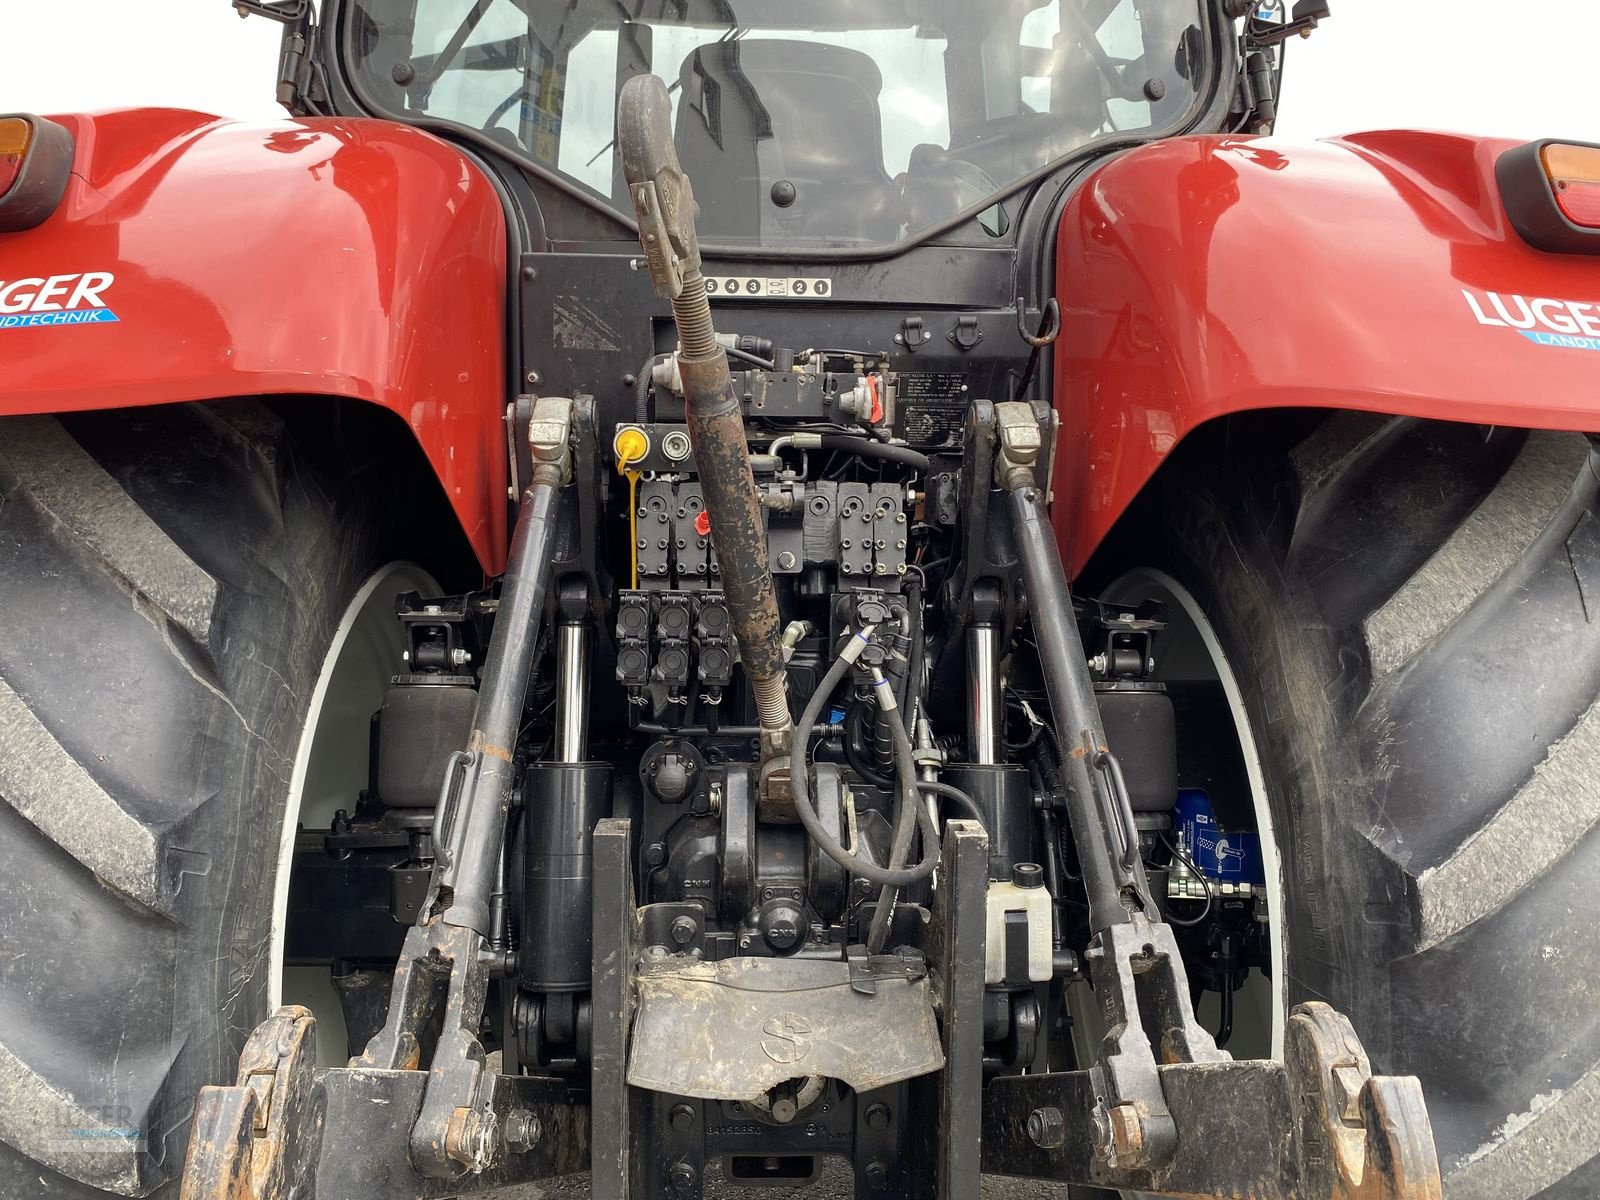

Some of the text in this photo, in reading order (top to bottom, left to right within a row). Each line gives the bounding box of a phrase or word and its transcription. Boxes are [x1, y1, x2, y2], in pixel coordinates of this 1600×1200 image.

[0, 271, 115, 314] GER
[0, 310, 103, 328] DTECHNIK
[1460, 288, 1600, 337] LUGE
[1535, 332, 1600, 350] LANDT
[683, 879, 712, 889] CNH
[767, 928, 798, 938] CNH
